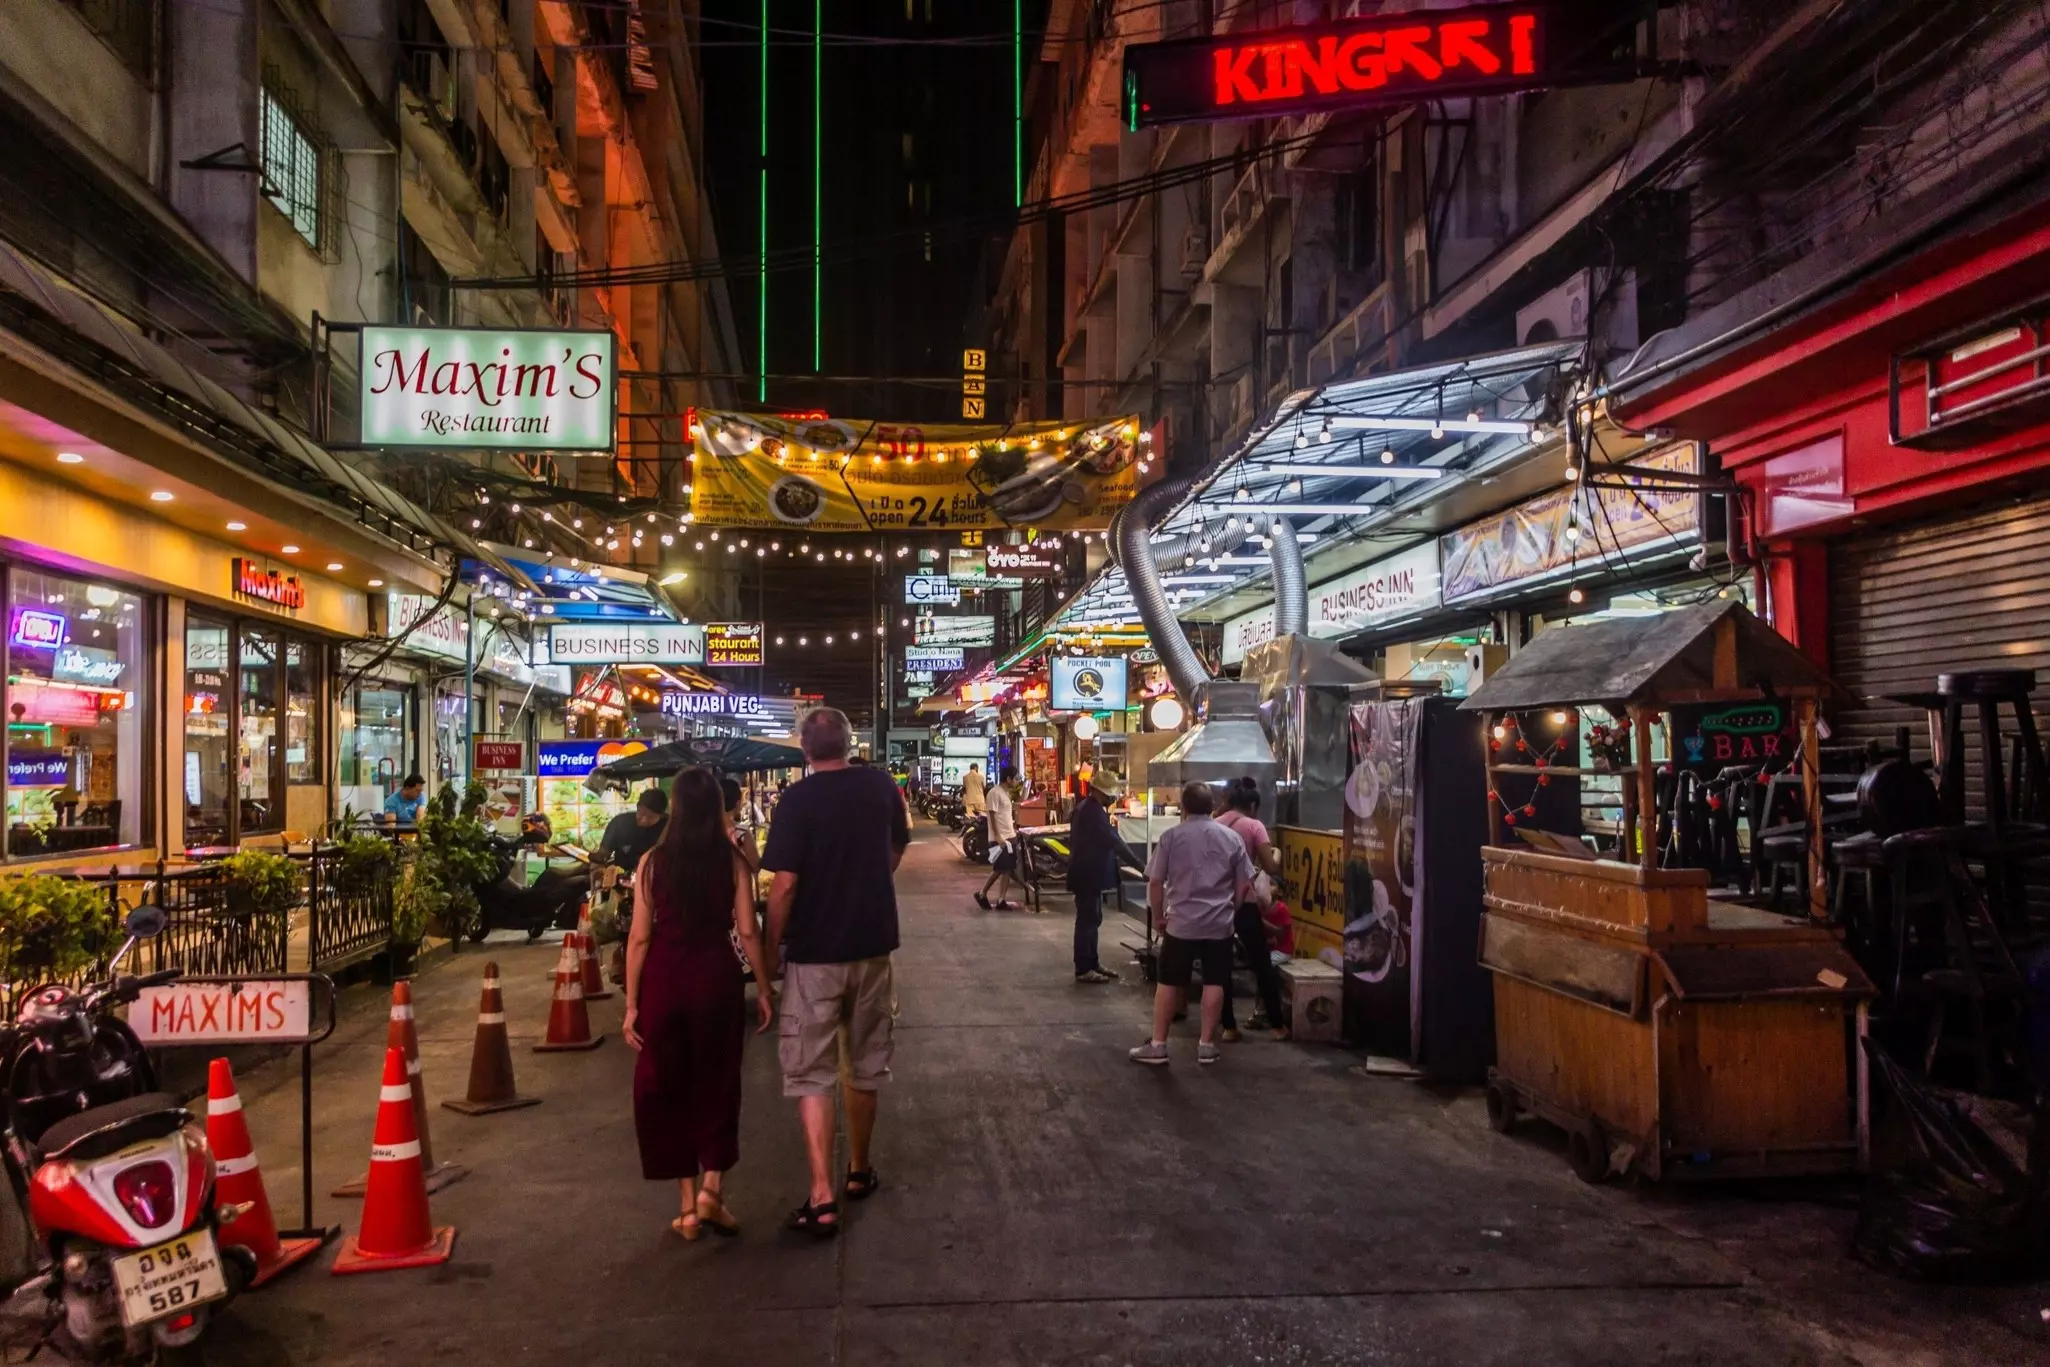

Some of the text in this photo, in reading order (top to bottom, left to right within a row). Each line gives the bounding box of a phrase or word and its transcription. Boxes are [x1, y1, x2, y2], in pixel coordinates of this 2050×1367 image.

[421, 410, 552, 435] Restaurant
[877, 426, 924, 462] 50
[870, 510, 987, 526] open hours
[908, 496, 948, 527] 24
[1321, 568, 1414, 621] BUSINESS INN
[555, 638, 659, 655] BUSINESS
[668, 638, 701, 655] INN
[712, 652, 760, 662] 24 Hours
[906, 659, 964, 668] PRESIDENT
[662, 695, 724, 713] PUNJABI
[482, 745, 517, 755] BUSINESS
[1714, 734, 1782, 760] BAR
[492, 756, 506, 765] INN
[540, 755, 558, 766] We
[560, 754, 594, 766] Prefer
[1301, 846, 1326, 917] 24
[152, 992, 284, 1034] MAXIMS
[150, 1280, 200, 1313] 587
